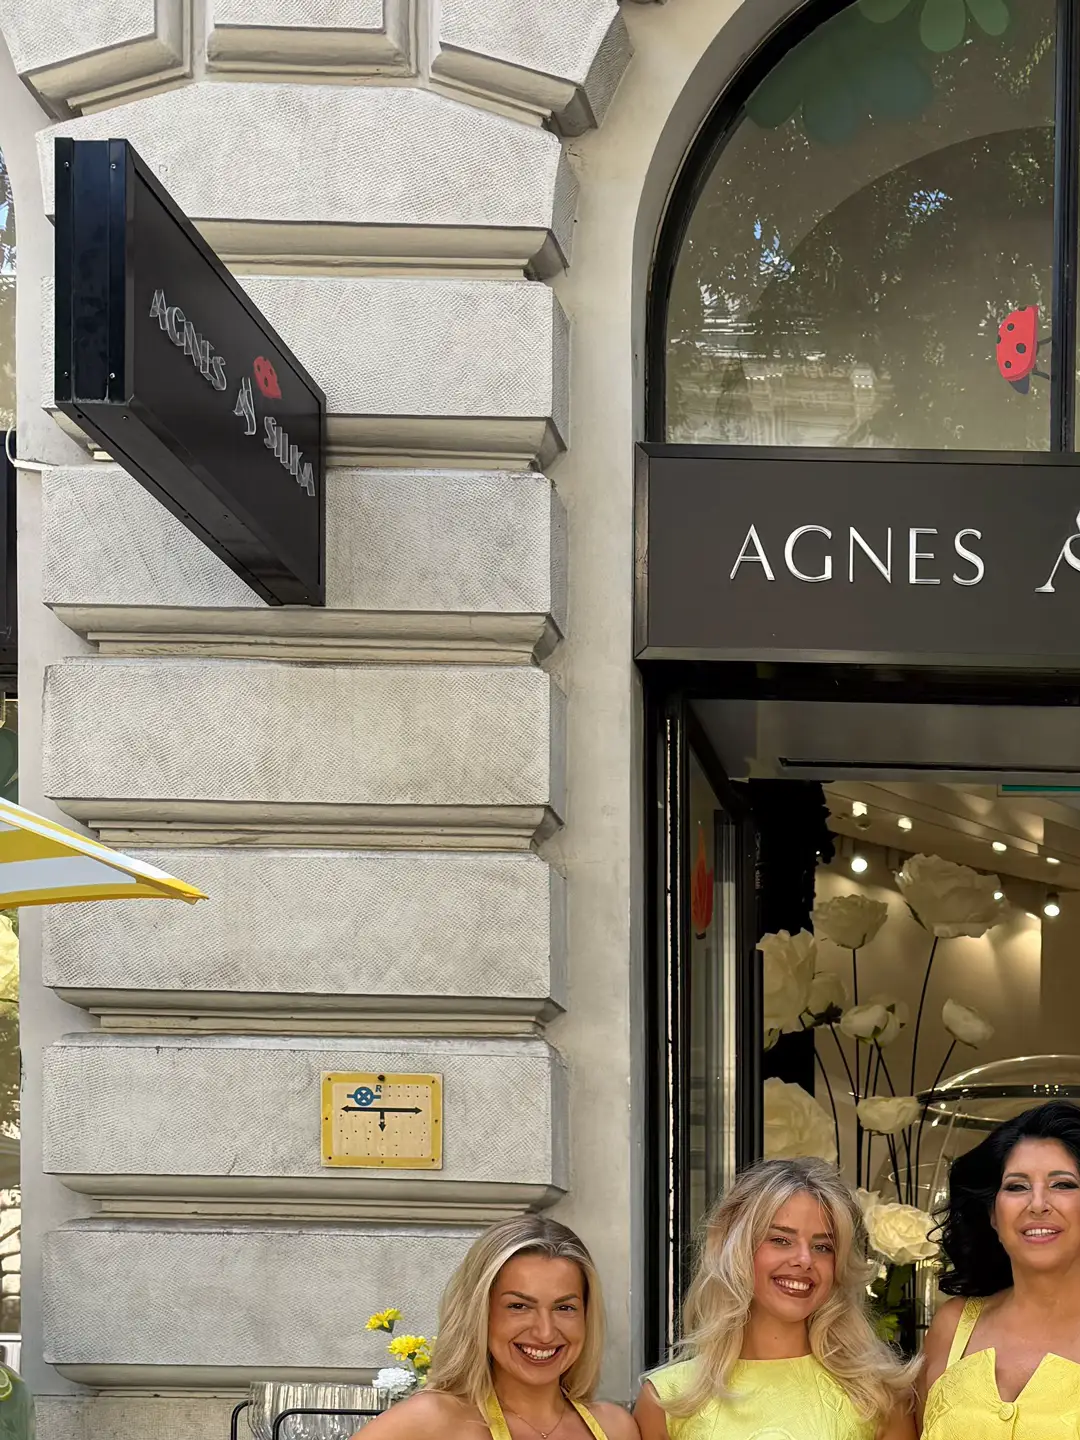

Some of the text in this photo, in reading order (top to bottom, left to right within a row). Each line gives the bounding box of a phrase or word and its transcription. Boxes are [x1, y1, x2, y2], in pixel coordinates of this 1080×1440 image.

[149, 289, 227, 391] AGNES
[263, 416, 316, 497] SILKA
[729, 523, 985, 586] AGNES
